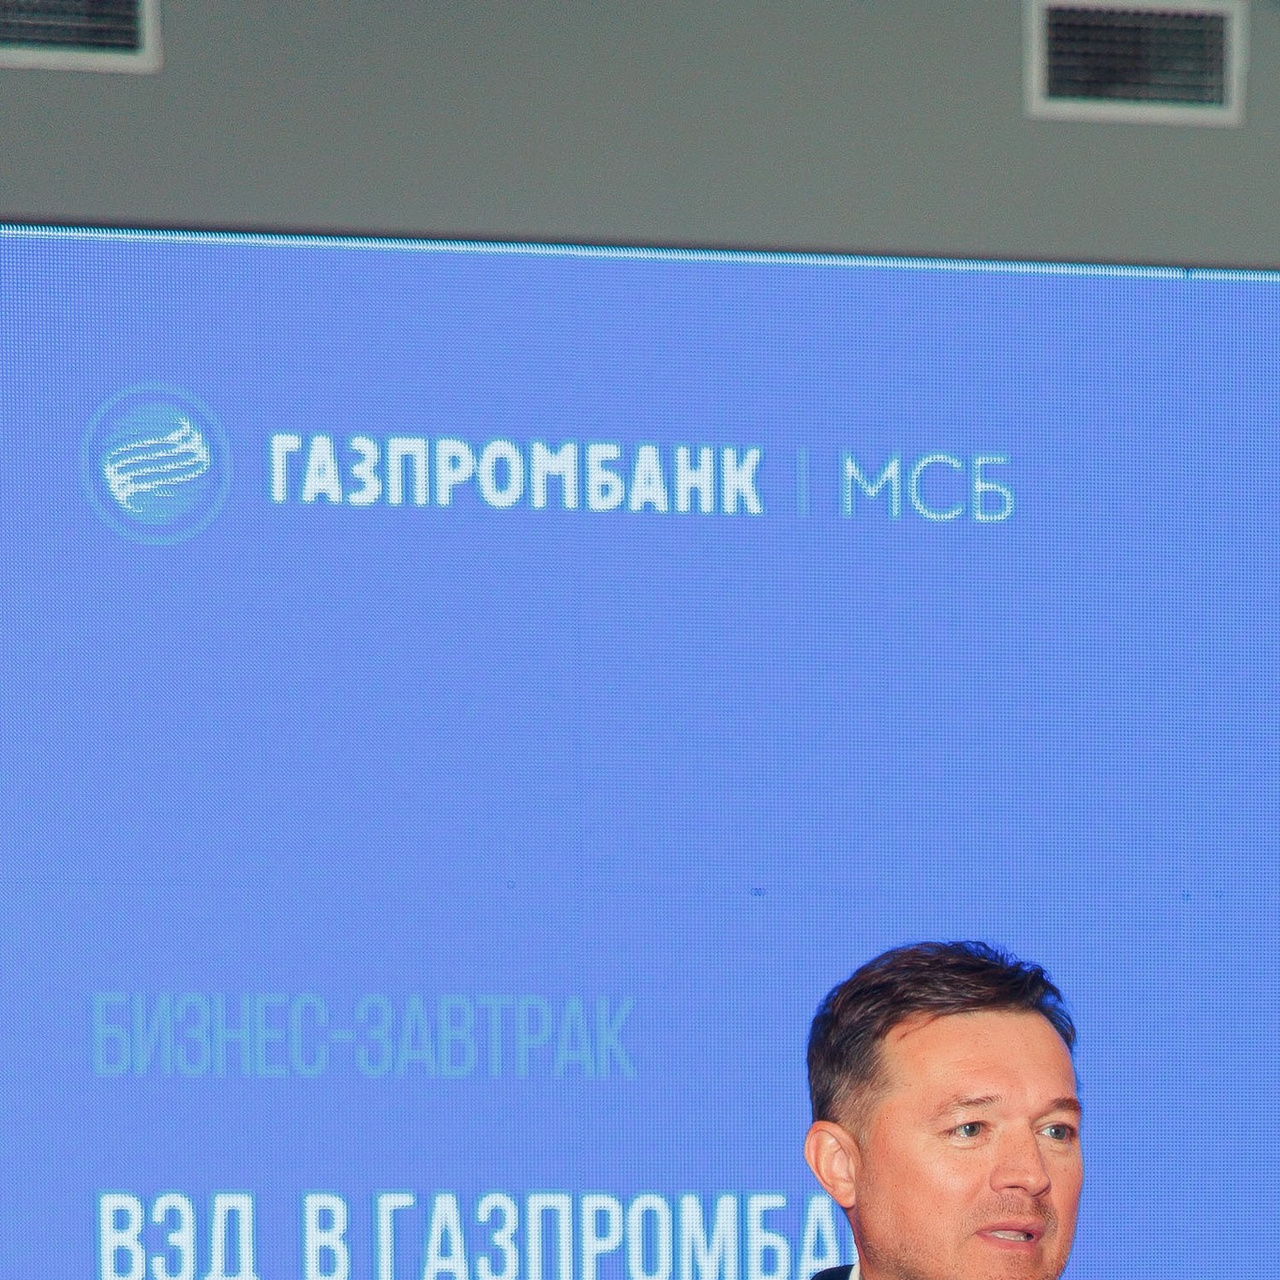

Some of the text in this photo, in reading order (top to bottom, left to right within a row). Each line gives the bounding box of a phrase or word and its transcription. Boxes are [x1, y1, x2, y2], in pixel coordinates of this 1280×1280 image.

[271, 434, 1015, 523] ГАЗПРОМБАНК МСБ
[90, 991, 637, 1080] БИЗНЕС-ЗАВТРАК
